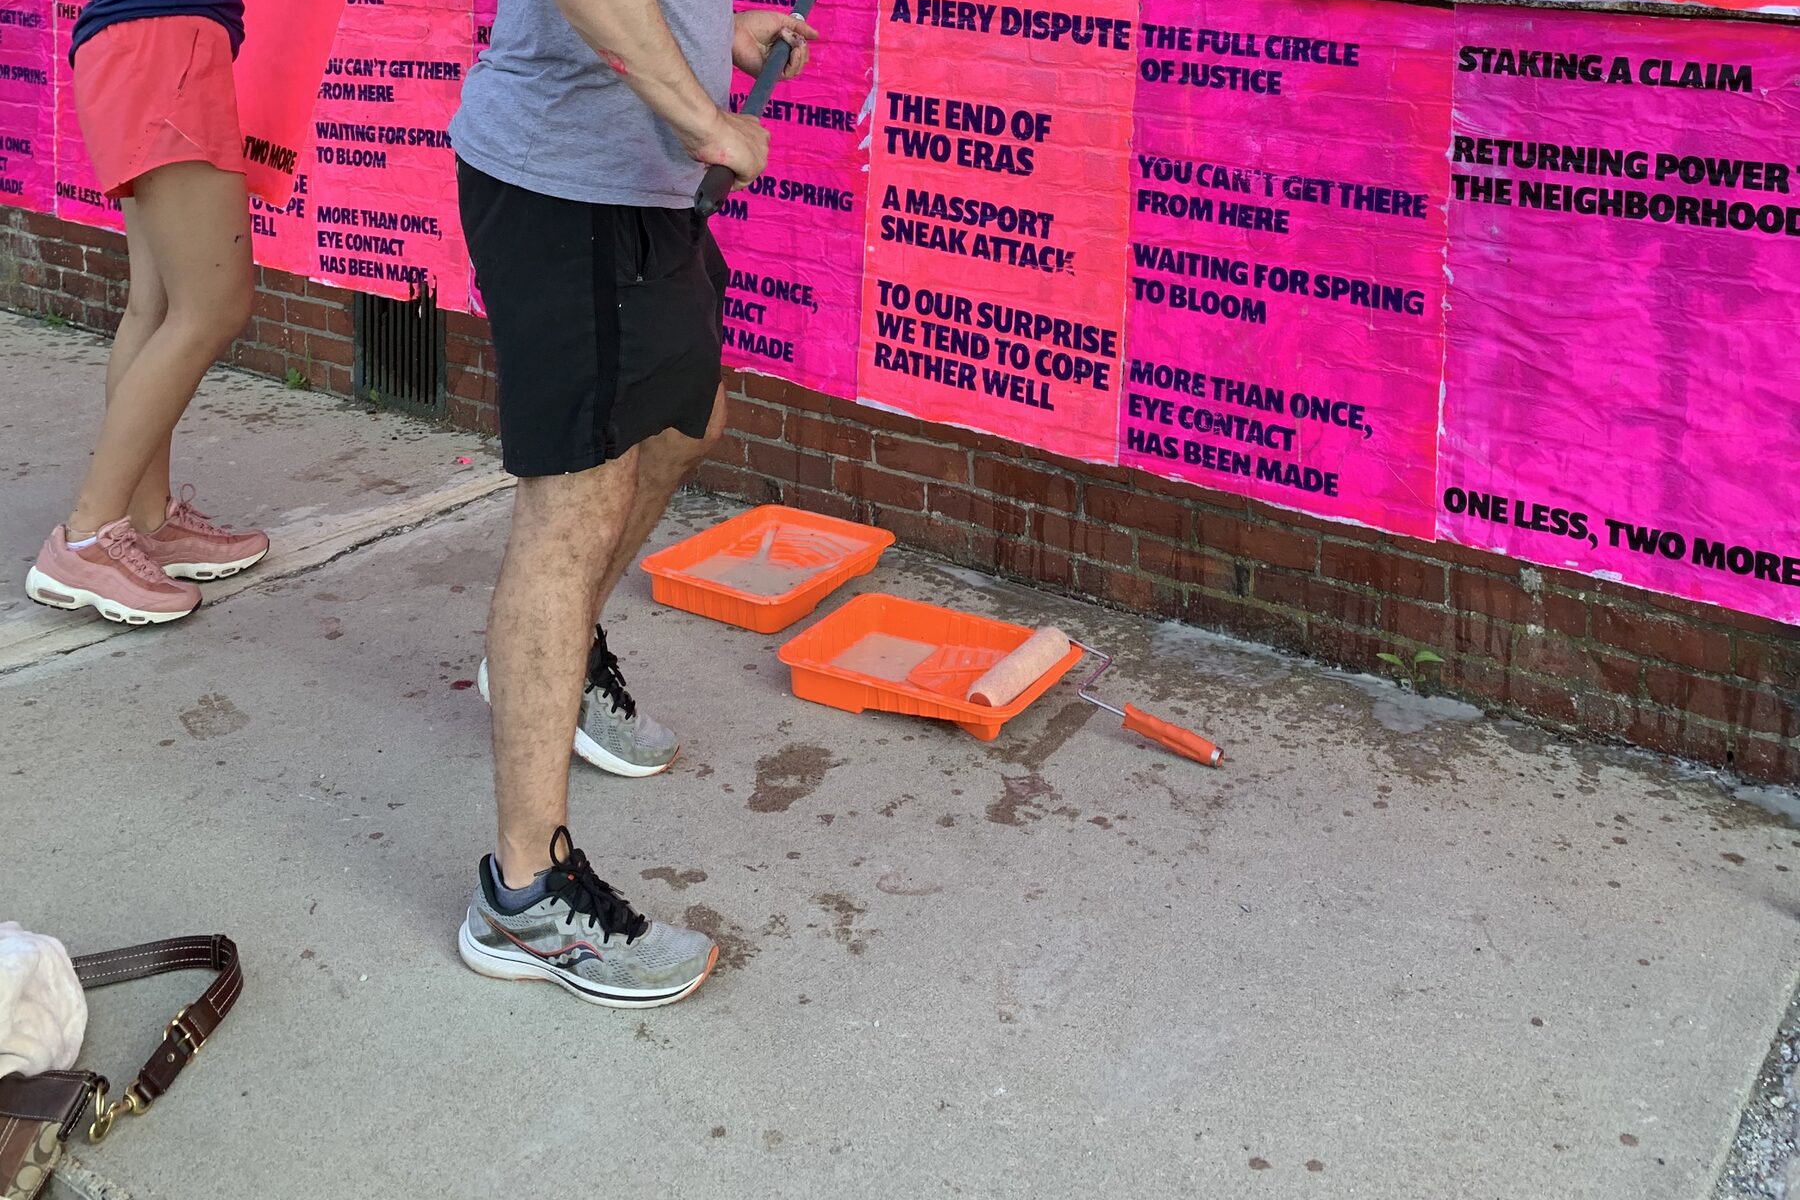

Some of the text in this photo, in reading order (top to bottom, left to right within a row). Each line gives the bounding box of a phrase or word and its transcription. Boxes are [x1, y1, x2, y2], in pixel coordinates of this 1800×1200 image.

[57, 3, 76, 20] THE
[1001, 7, 1131, 50] DISPUTE
[1142, 24, 1359, 66] THE FULL CIRCLE
[11, 65, 47, 86] SPRING
[389, 60, 416, 79] GET
[416, 61, 461, 81] THERE
[1141, 59, 1282, 94] OF JUSTICE
[1458, 46, 1752, 92] STAKING A CLAIM
[358, 84, 395, 102] HERE
[316, 121, 452, 149] WAITING FOR SPRIN
[795, 103, 857, 133] THERE
[887, 92, 1051, 142] THE END OF
[5, 136, 34, 160] ONCE,
[243, 135, 297, 175] TWO MORE
[316, 146, 387, 169] TO BLOOM
[885, 126, 1033, 176] TWO ERAS
[1453, 135, 1790, 194] RETURNING POWER
[56, 181, 76, 200] ONE
[78, 187, 105, 212] LESS,
[749, 176, 777, 197] OR
[778, 179, 854, 212] SPRING
[1139, 155, 1192, 184] YOU
[1283, 176, 1334, 205] GET
[1338, 182, 1428, 219] THERE
[1452, 174, 1512, 206] THE
[250, 213, 277, 237] ELL
[317, 206, 443, 241] MORE THAN ONCE,
[883, 186, 1054, 239] A MASSPORT
[1138, 189, 1289, 233] FROM HERE
[317, 231, 405, 257] EYE CONTACT
[881, 216, 1076, 276] SNEAK ATTACK
[320, 255, 428, 284] HAS BEEN MADE
[1134, 244, 1424, 315] WAITING FOR SPRING
[724, 297, 767, 325] TACT
[761, 276, 818, 314] ONCE,
[1133, 277, 1266, 324] TO BLOOM
[878, 280, 1117, 359] TO OUR SURPRISE
[738, 329, 794, 362] MADE
[877, 311, 1109, 390] WE TEND TO COPE
[875, 343, 1053, 410] RATHER WELL
[1130, 360, 1372, 438] MORE THAN ONCE,
[1129, 394, 1296, 451] EYE CONTACT
[1128, 428, 1338, 496] HAS BEEN MADE
[1444, 488, 1800, 586] ONE LESS, TWO MORE
